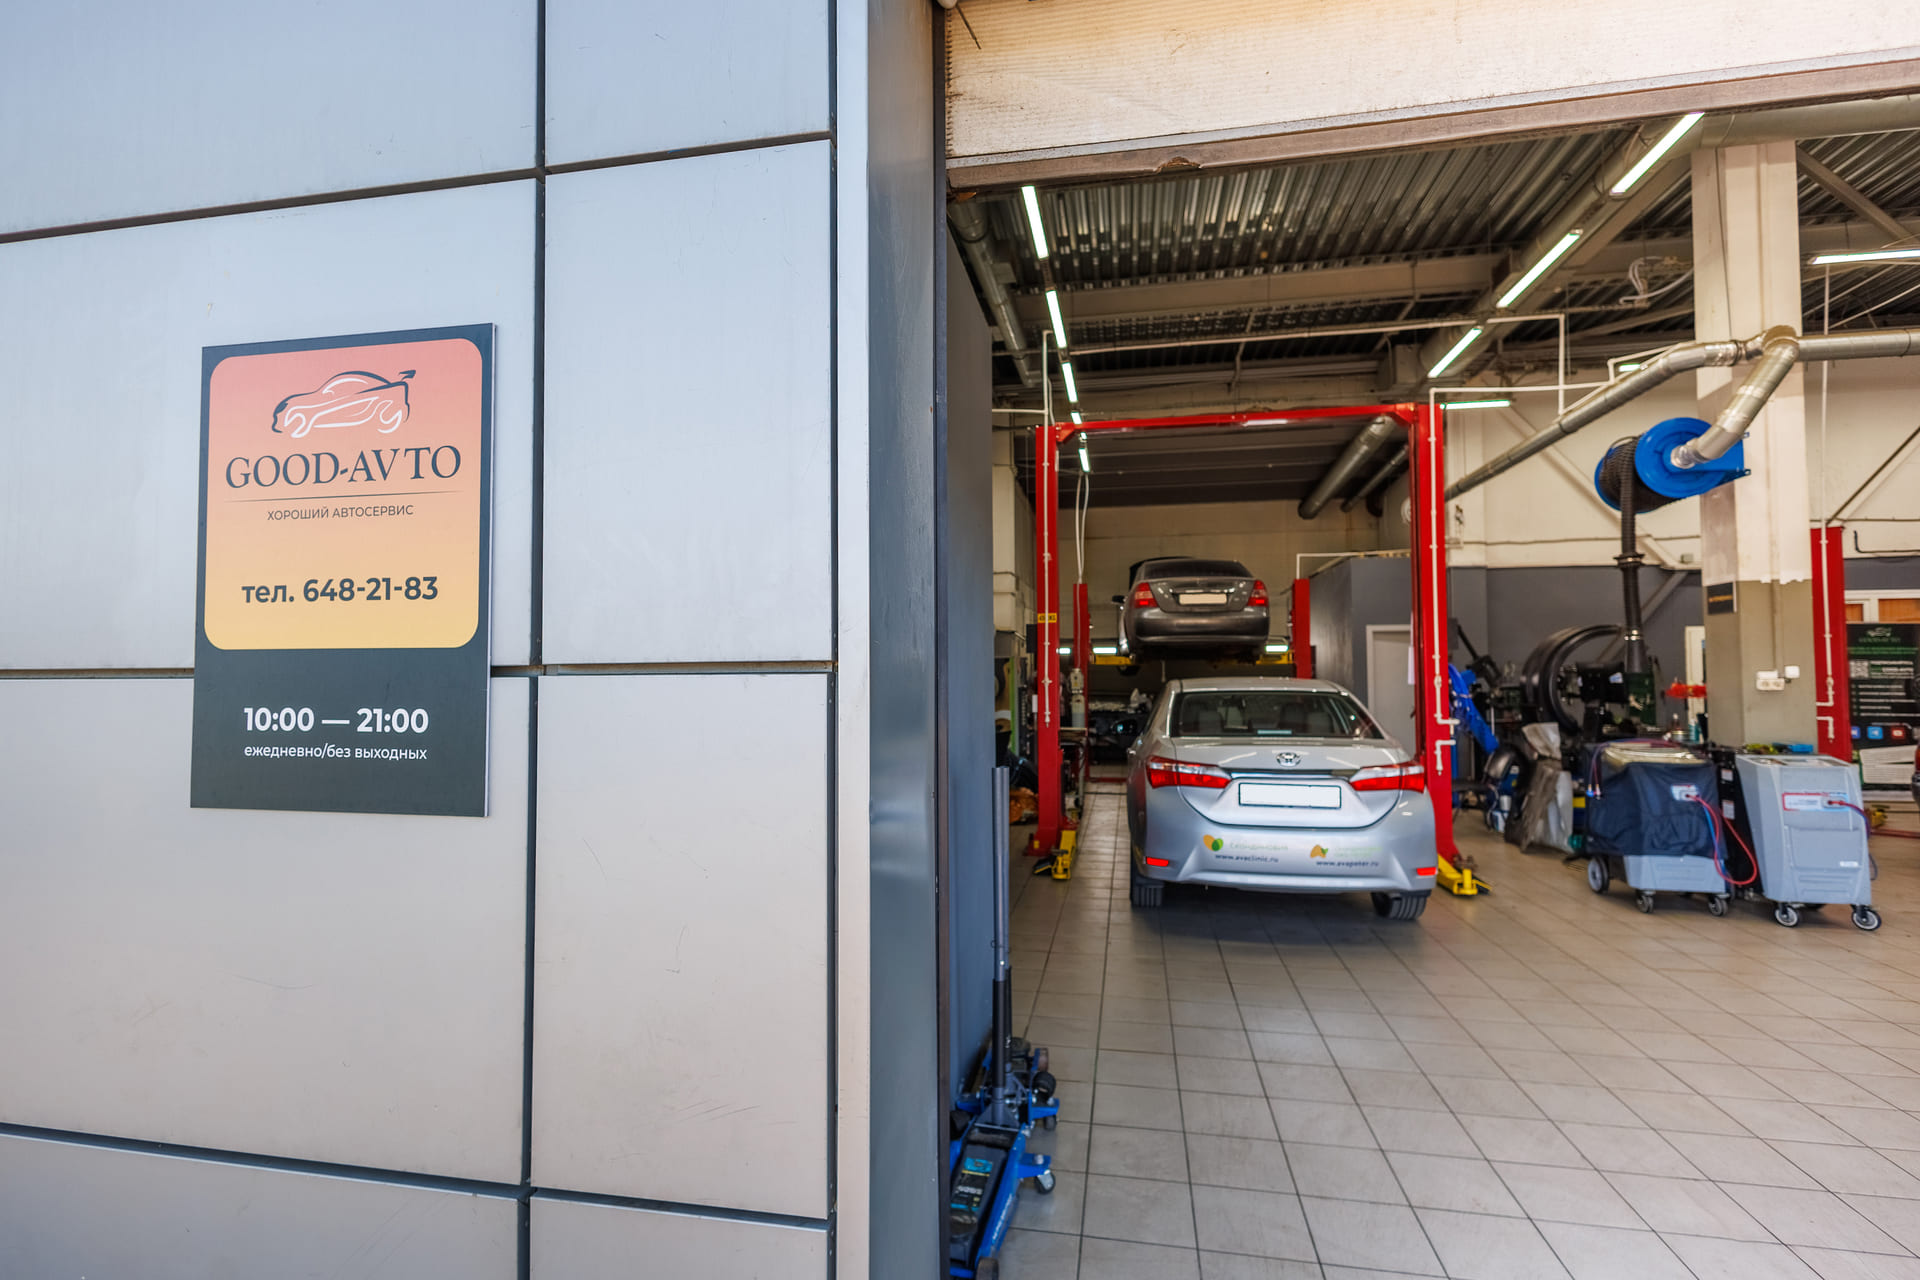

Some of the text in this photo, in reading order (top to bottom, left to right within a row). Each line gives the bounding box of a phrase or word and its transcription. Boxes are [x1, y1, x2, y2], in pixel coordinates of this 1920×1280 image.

[225, 445, 462, 488] GOOD-AVTO
[267, 504, 414, 520] ХОРОШИЙ АВТОСЕРВИС
[241, 576, 439, 603] тел. 648-21-83
[243, 706, 315, 732] 10:00
[356, 707, 430, 733] 21:00
[243, 742, 428, 761] ежедневно/без выходных
